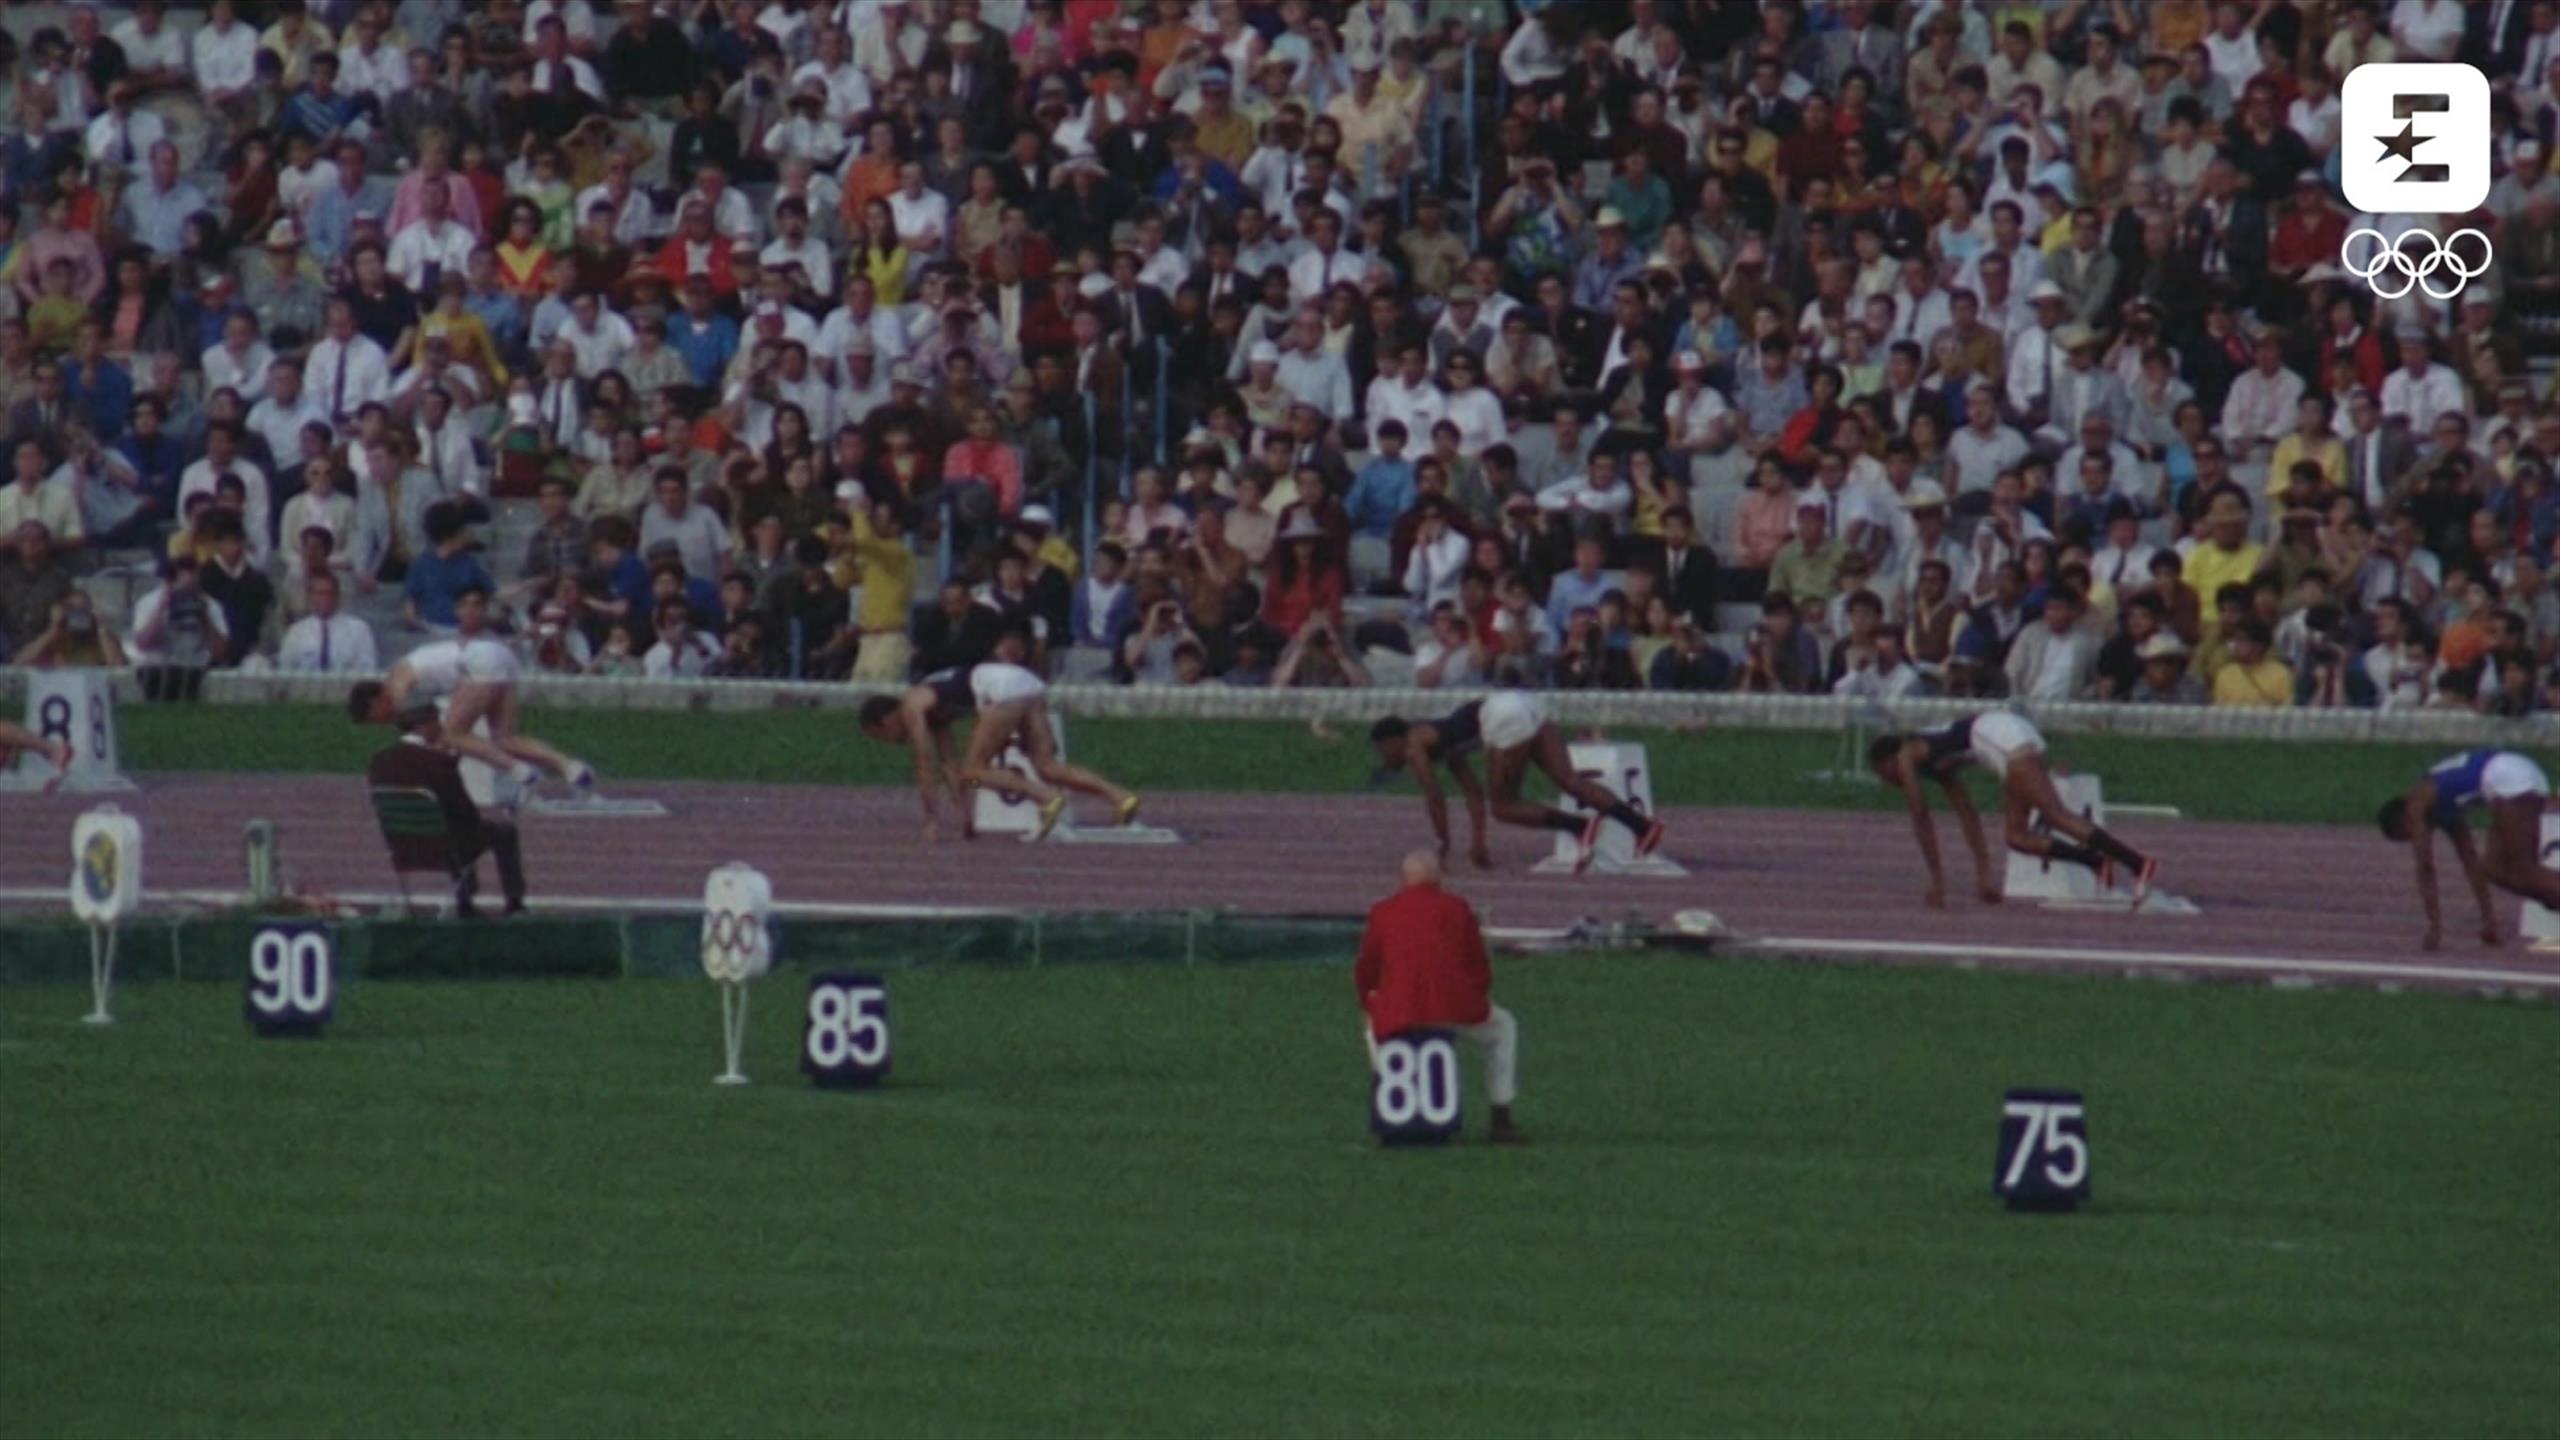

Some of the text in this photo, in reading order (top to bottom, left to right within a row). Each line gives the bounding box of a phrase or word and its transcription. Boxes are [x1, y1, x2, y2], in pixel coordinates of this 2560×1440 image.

[251, 929, 328, 1013] 90
[808, 984, 888, 1067] 85
[1376, 1039, 1458, 1125] 80
[2003, 1102, 2087, 1188] 75
